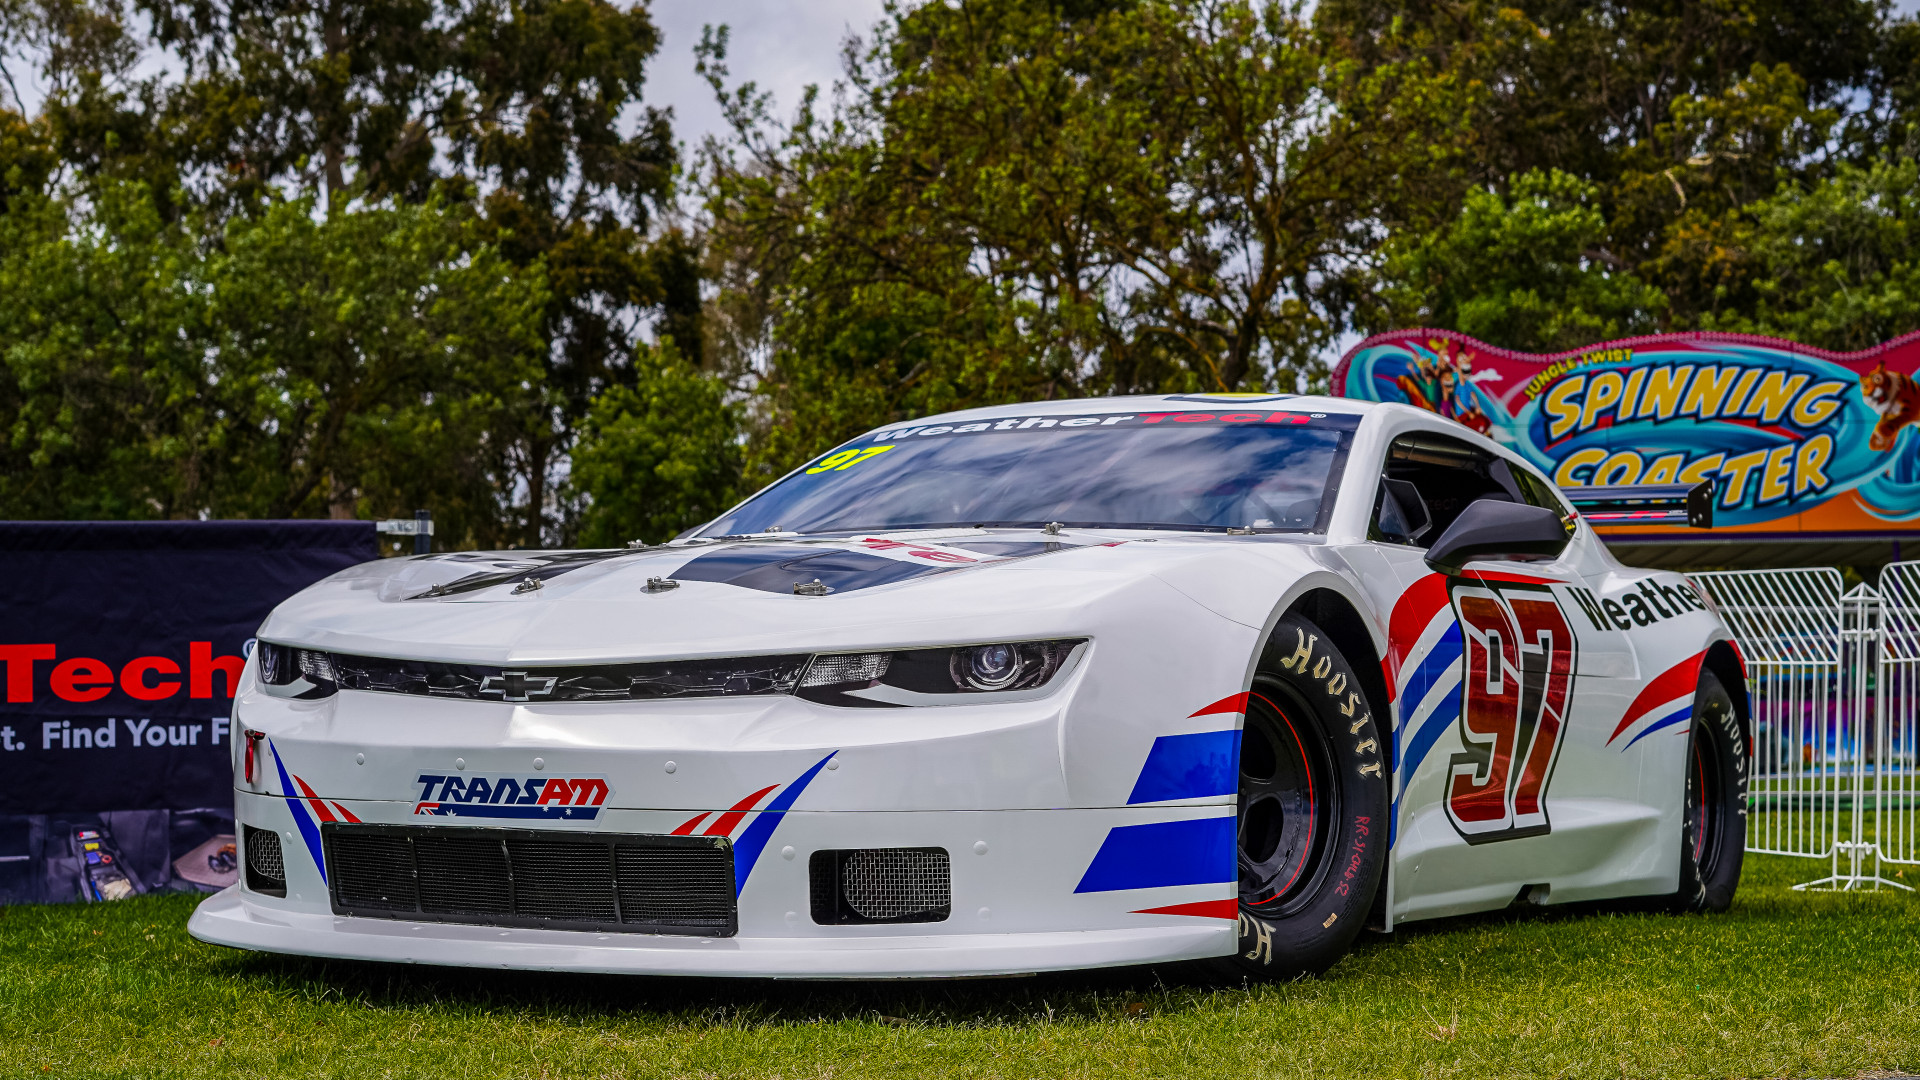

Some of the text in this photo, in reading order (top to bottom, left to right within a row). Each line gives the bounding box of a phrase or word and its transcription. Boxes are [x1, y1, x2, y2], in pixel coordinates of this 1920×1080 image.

[1524, 348, 1633, 401] JUNGLE TWIST
[1544, 364, 1847, 440] SPINNING
[806, 445, 895, 475] 97
[1553, 433, 1833, 507] COASTER
[42, 719, 116, 750] Find
[125, 718, 201, 747] Your
[1280, 627, 1382, 780] Hoosier
[1444, 578, 1577, 846] 97
